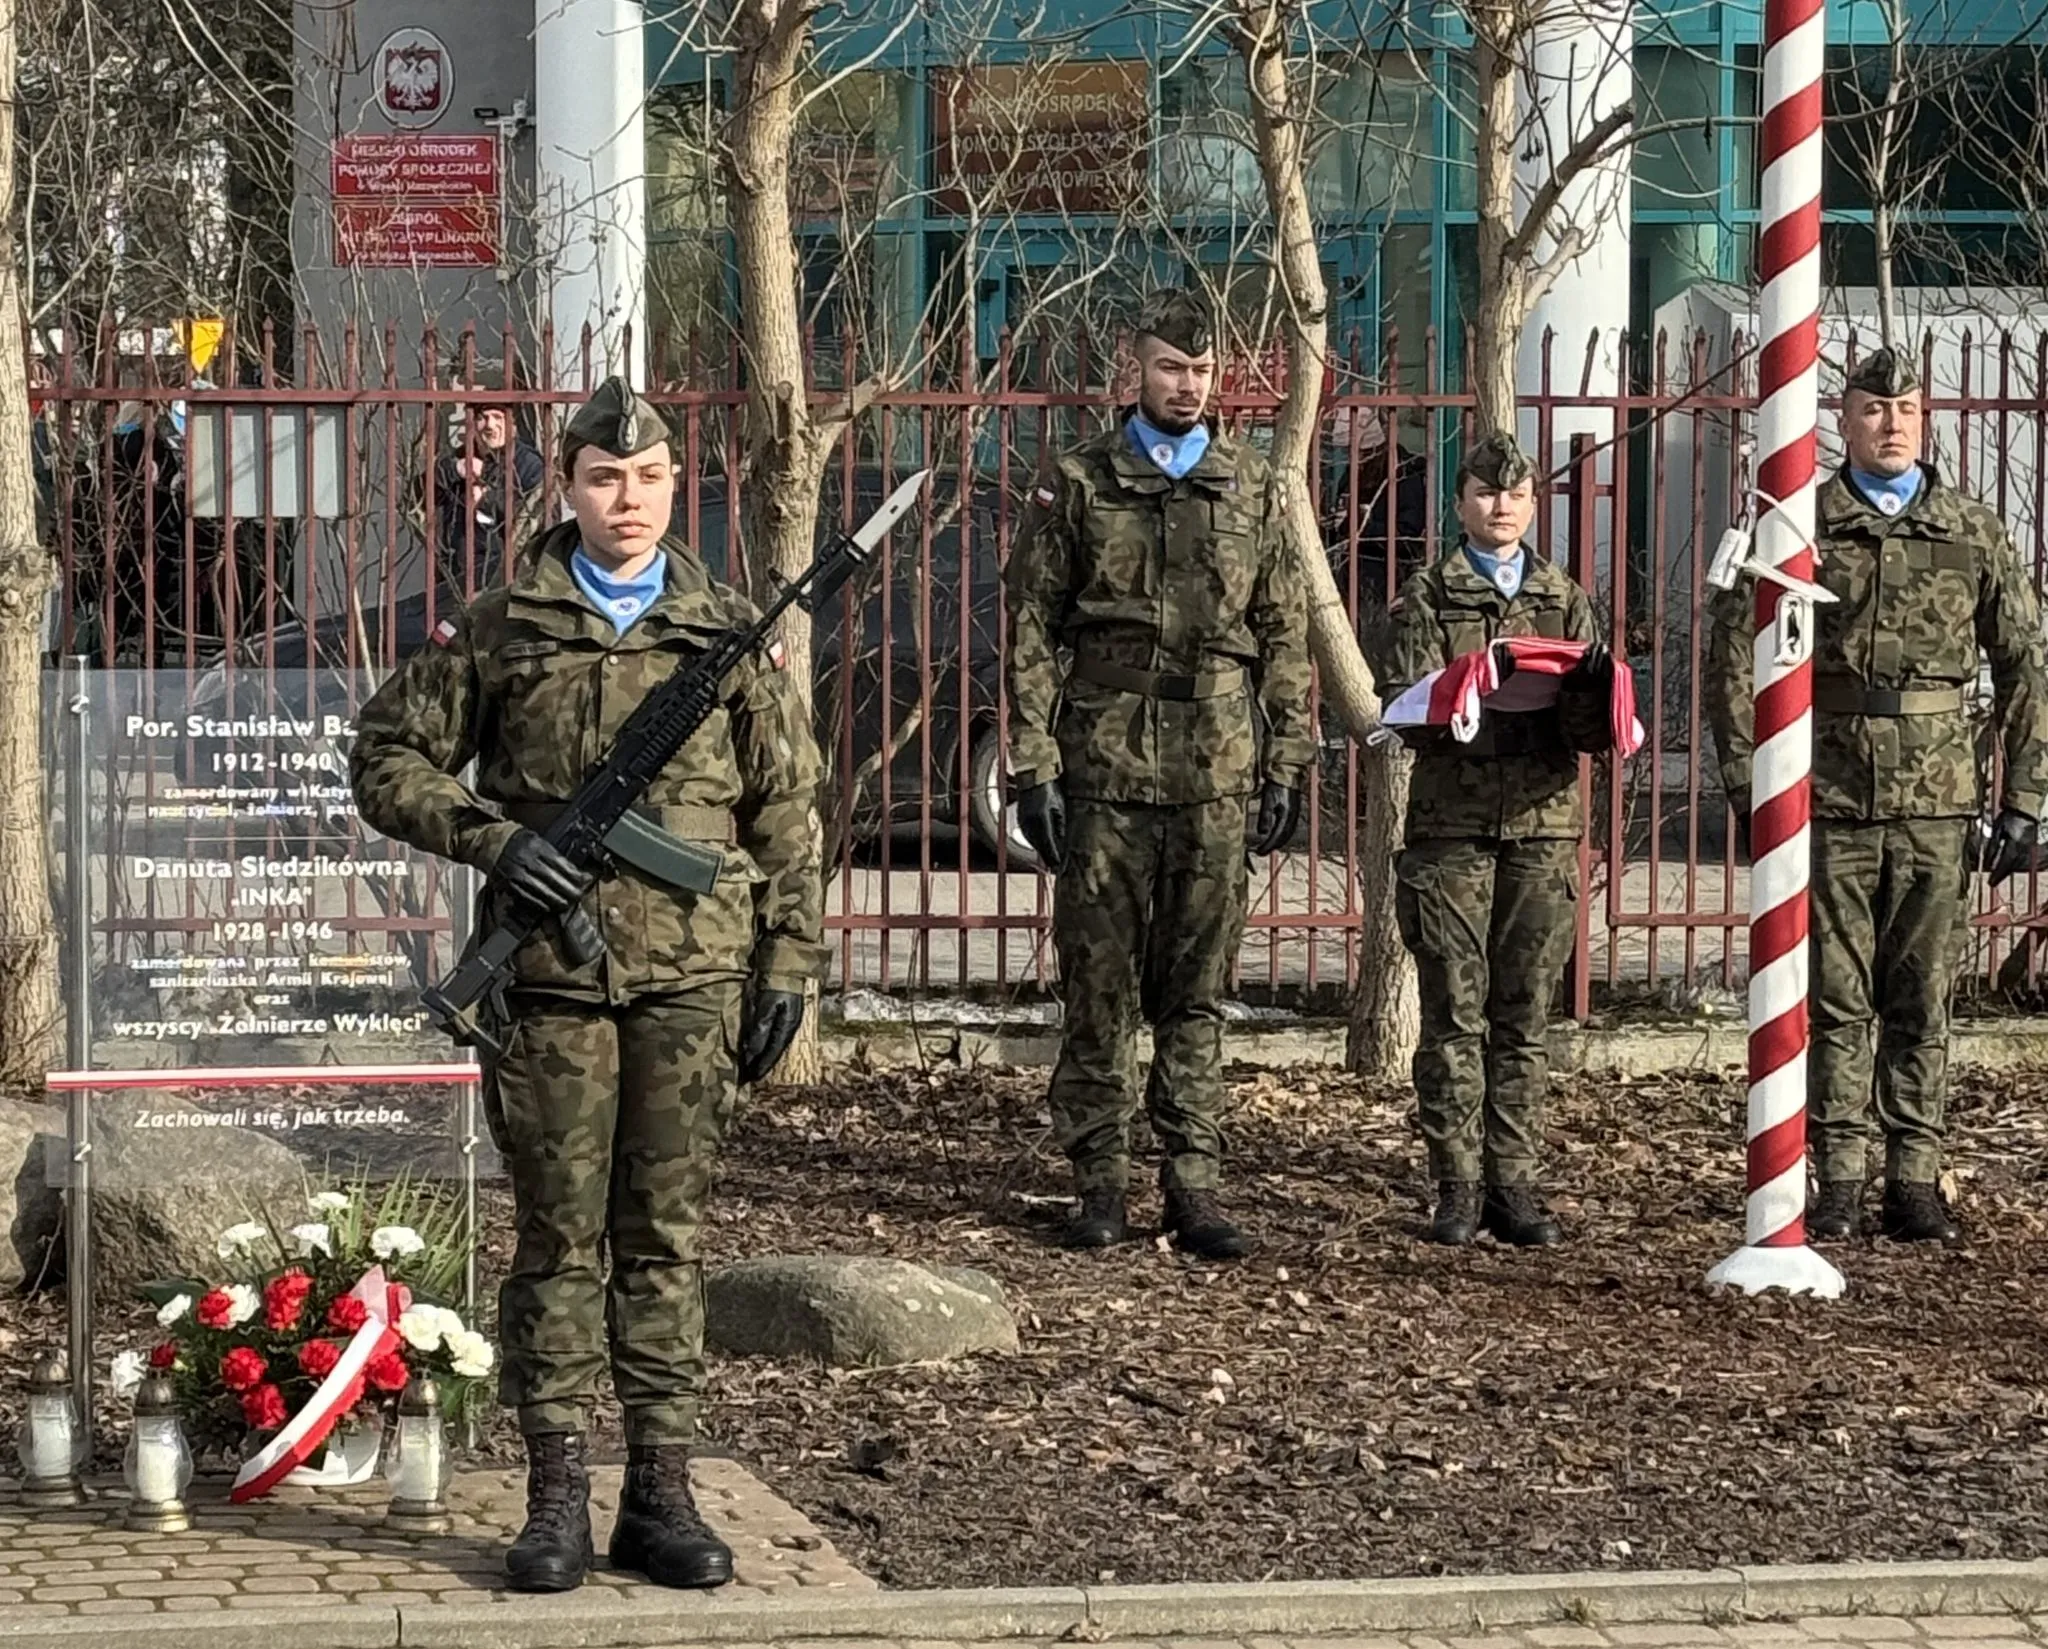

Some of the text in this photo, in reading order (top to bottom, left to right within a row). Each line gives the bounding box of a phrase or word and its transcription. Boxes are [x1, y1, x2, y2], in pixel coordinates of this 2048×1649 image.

[408, 141, 478, 157] OŚRODEK
[402, 163, 491, 176] SPOŁECZNEJ
[126, 715, 178, 738] Por.
[186, 714, 315, 738] Stanisław
[212, 752, 333, 772] 1912-1940
[163, 785, 279, 802] zamordowany
[287, 788, 299, 799] w
[133, 854, 408, 879] Danuta Siedzikówna
[213, 921, 334, 942] 1928-1946
[130, 951, 413, 972] zamordowana przez komunistów,
[149, 969, 394, 989] sanitariuszka Armii Krajowej
[252, 992, 291, 1006] oraz
[112, 1018, 203, 1040] wszyscy
[133, 1105, 412, 1131] Zachowali się, jak trzeba.
